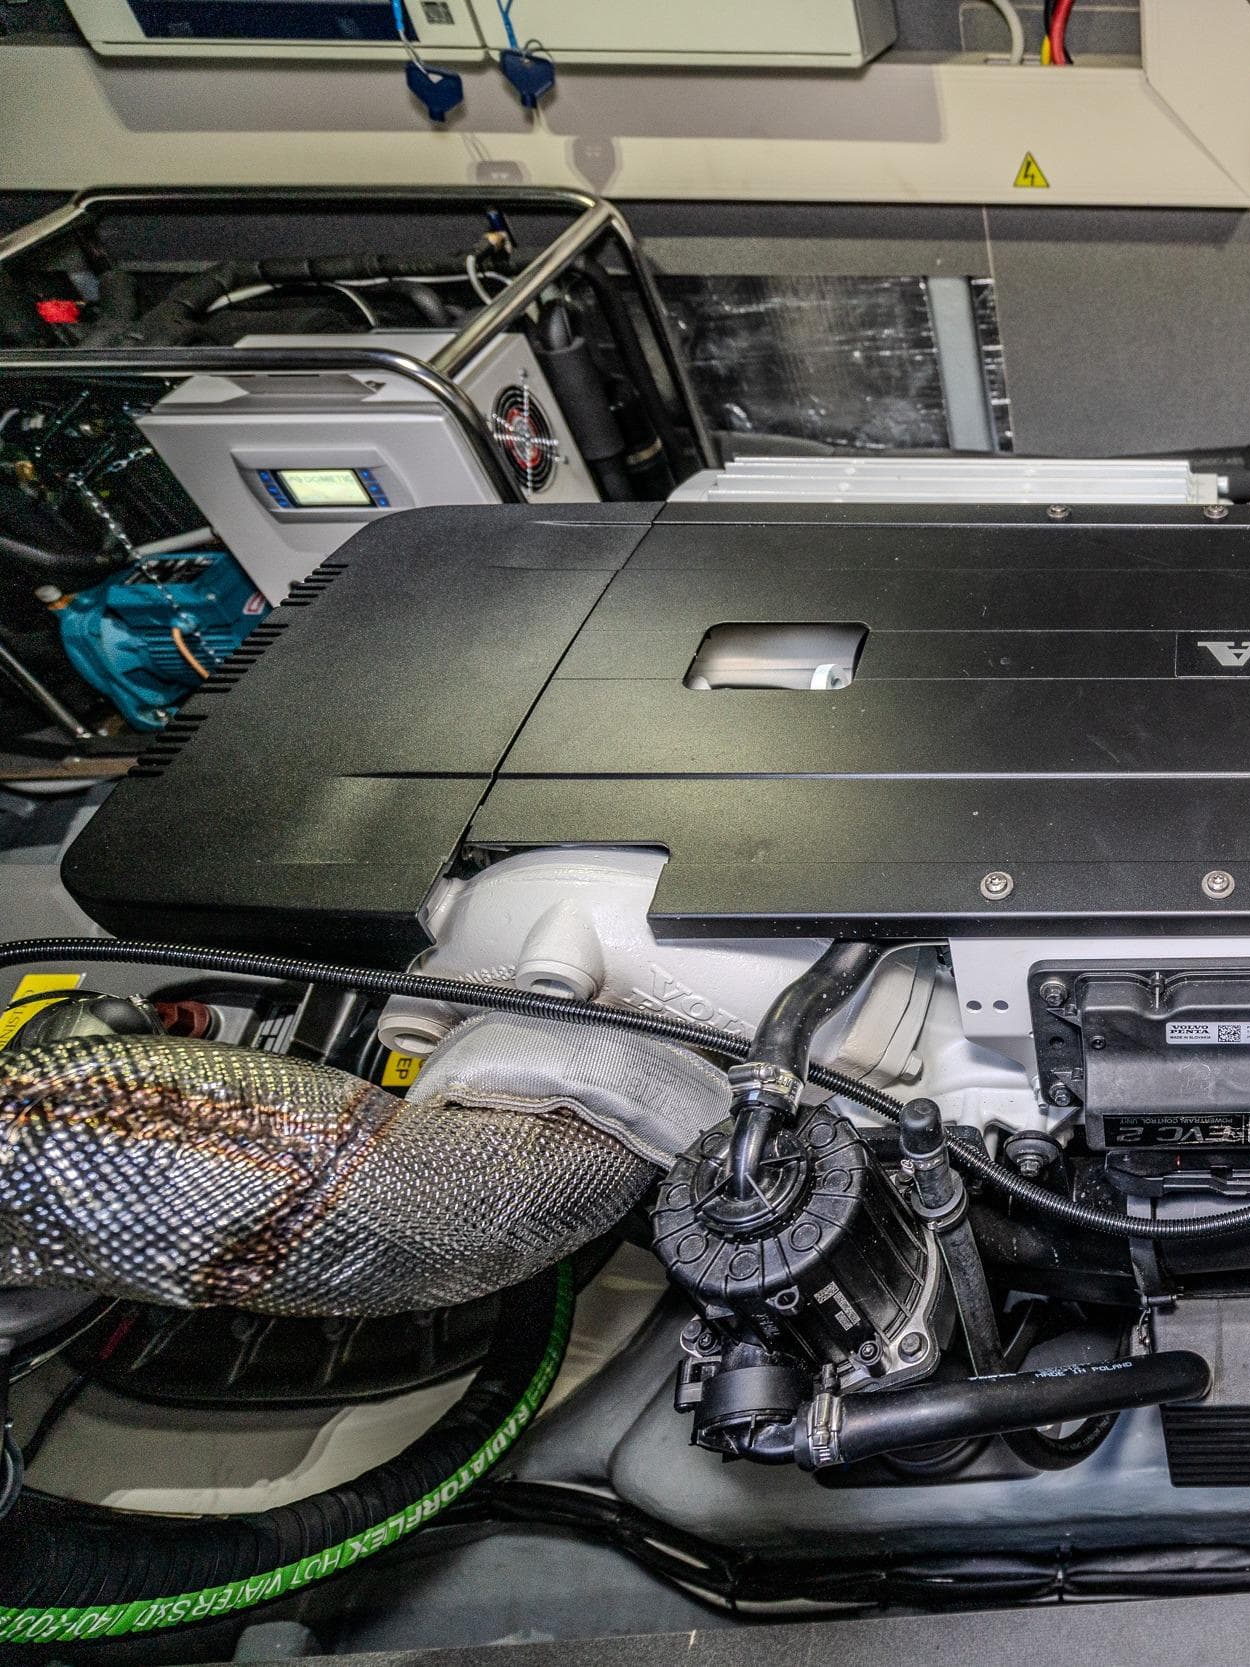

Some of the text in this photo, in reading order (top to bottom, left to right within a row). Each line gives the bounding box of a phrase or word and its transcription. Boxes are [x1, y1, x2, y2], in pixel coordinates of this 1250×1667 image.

[1181, 1116, 1233, 1124] POWERTRAIN
[1091, 1361, 1133, 1373] POLAND
[349, 1402, 532, 1561] RADIATORFLEX
